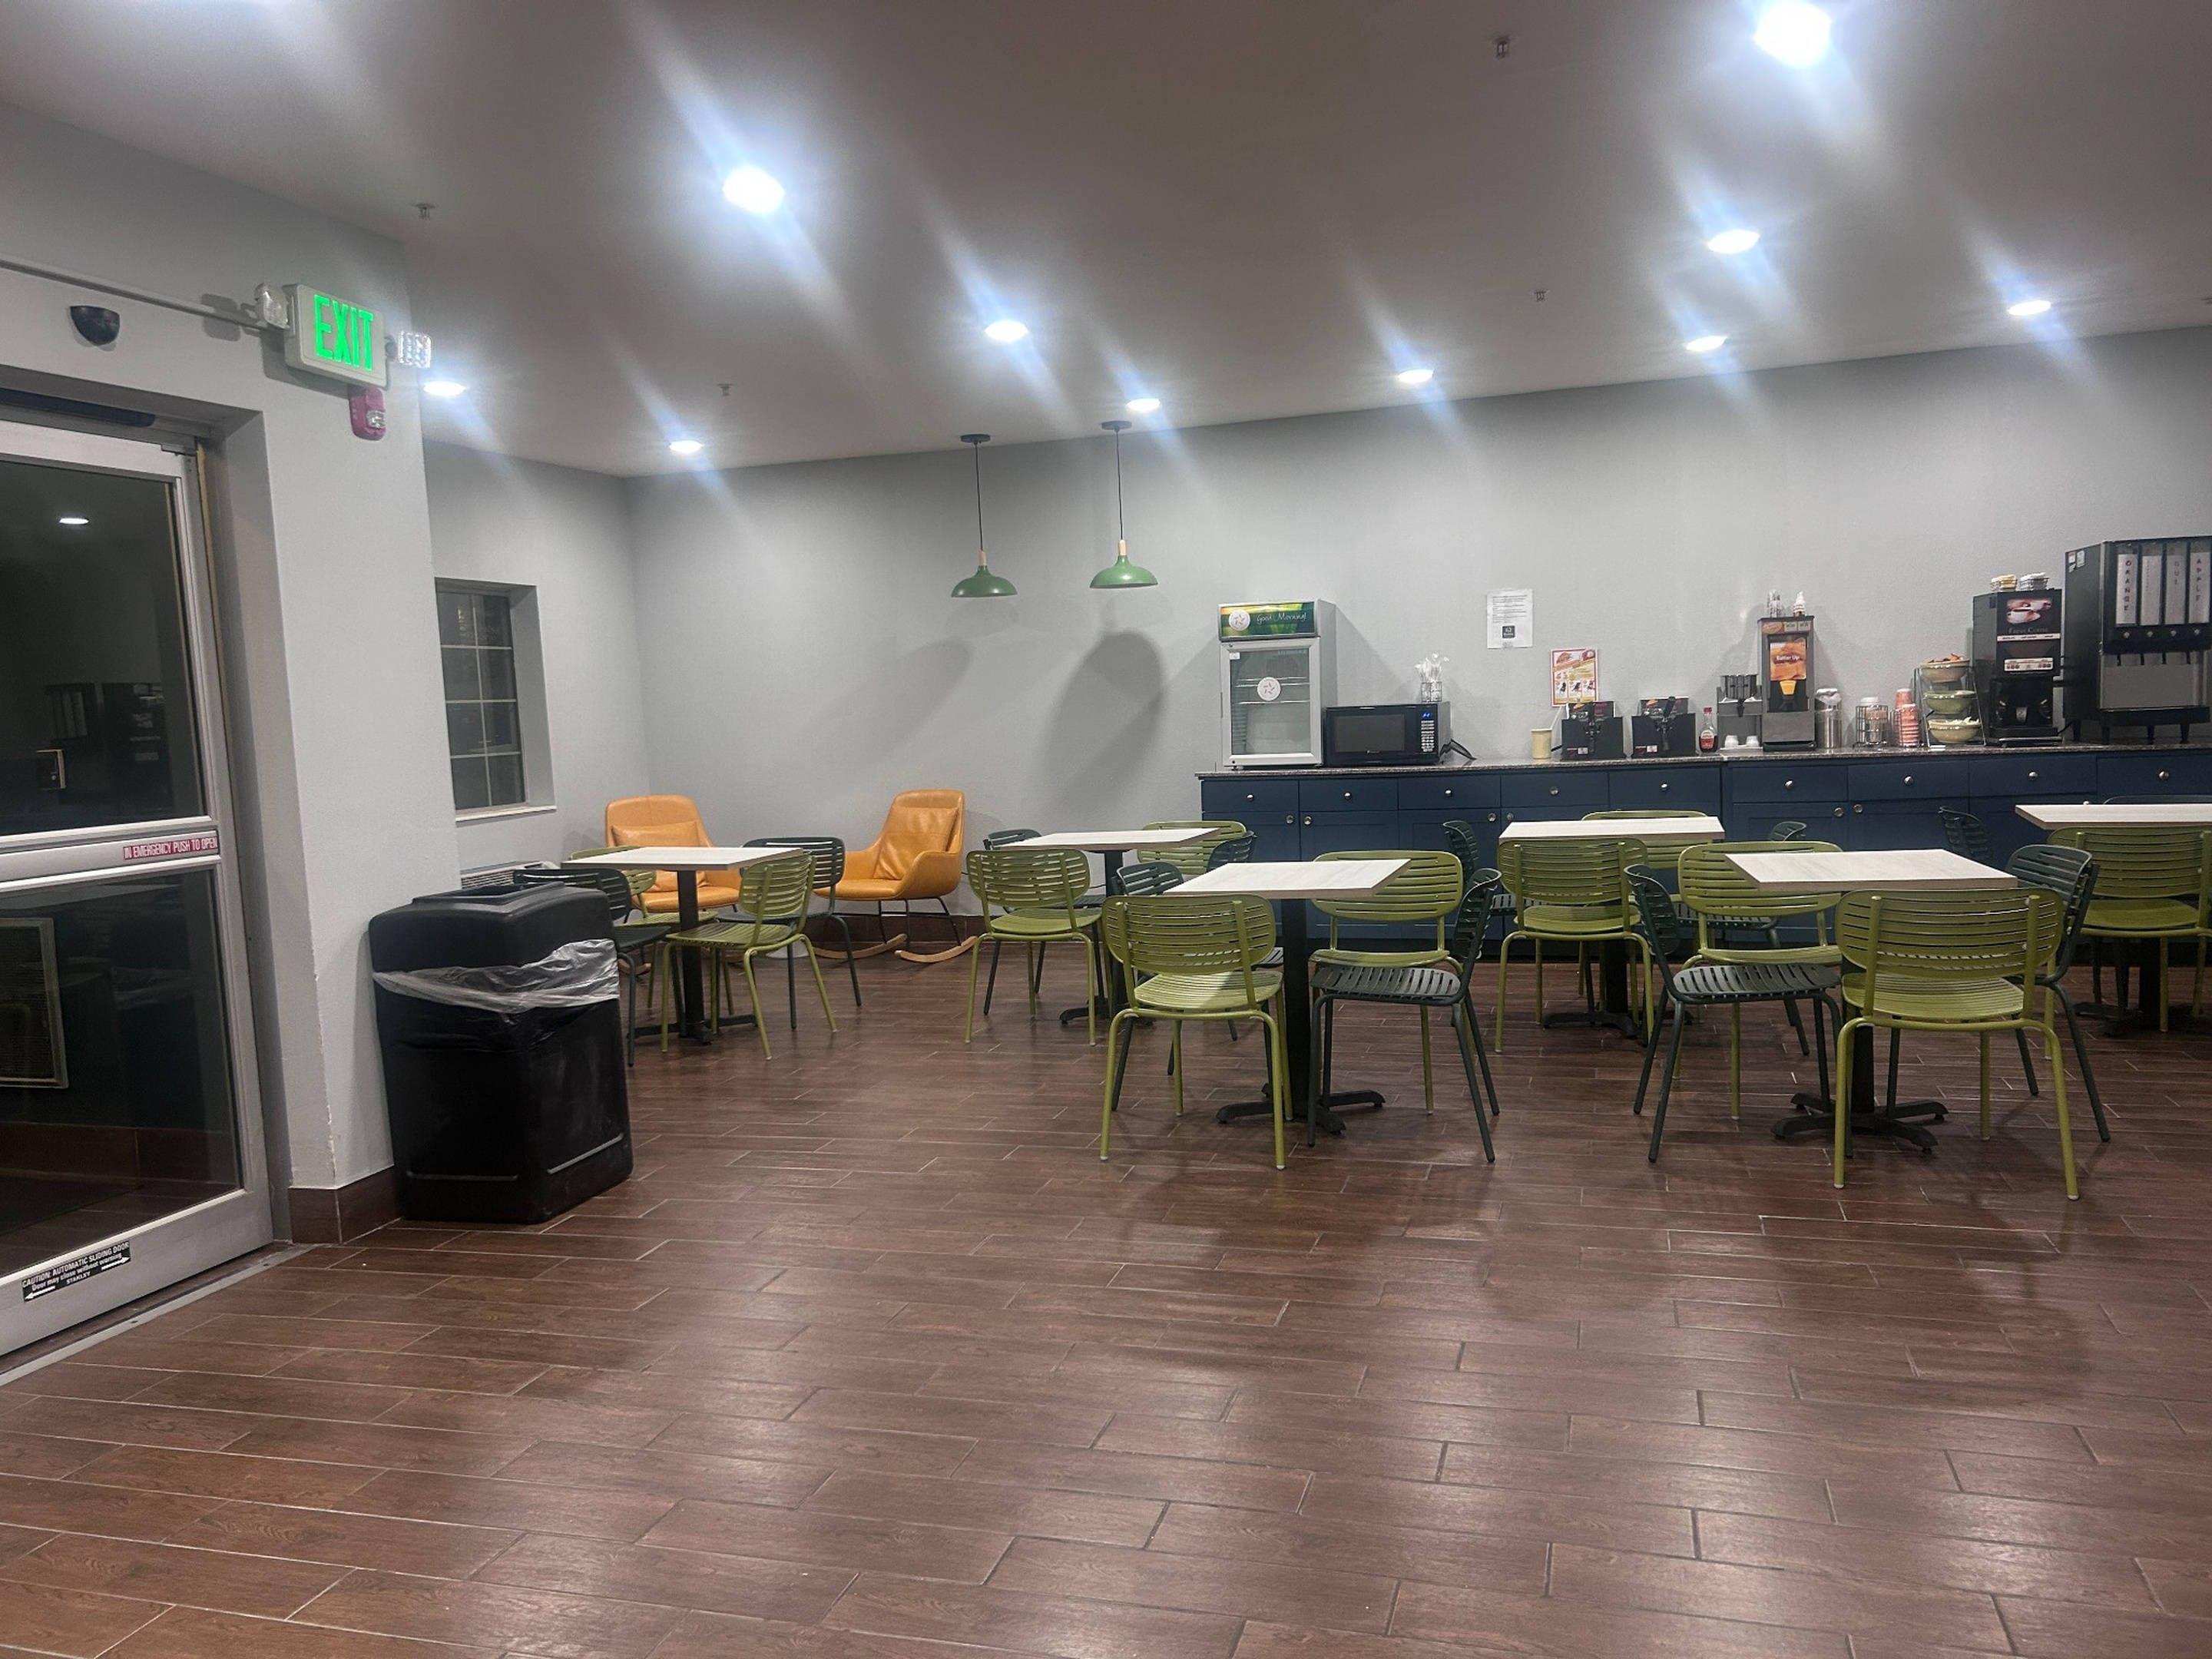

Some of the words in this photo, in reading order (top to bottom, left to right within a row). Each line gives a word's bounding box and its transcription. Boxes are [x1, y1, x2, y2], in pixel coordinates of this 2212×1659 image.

[313, 294, 374, 372] EXIT
[2124, 560, 2132, 611] ORANGE
[124, 847, 131, 859] IN
[133, 843, 171, 857] EMERGENCY
[174, 840, 190, 853] PUSH
[191, 839, 200, 850] TO
[201, 837, 218, 849] OPEN
[31, 1282, 47, 1291] Door
[47, 1277, 60, 1286] may
[60, 1270, 76, 1280] close
[77, 1261, 98, 1273] without
[99, 1253, 122, 1265] warning
[53, 1257, 88, 1276] AUTOMATIC
[88, 1248, 112, 1262] SLIDING
[113, 1242, 130, 1253] DOOR
